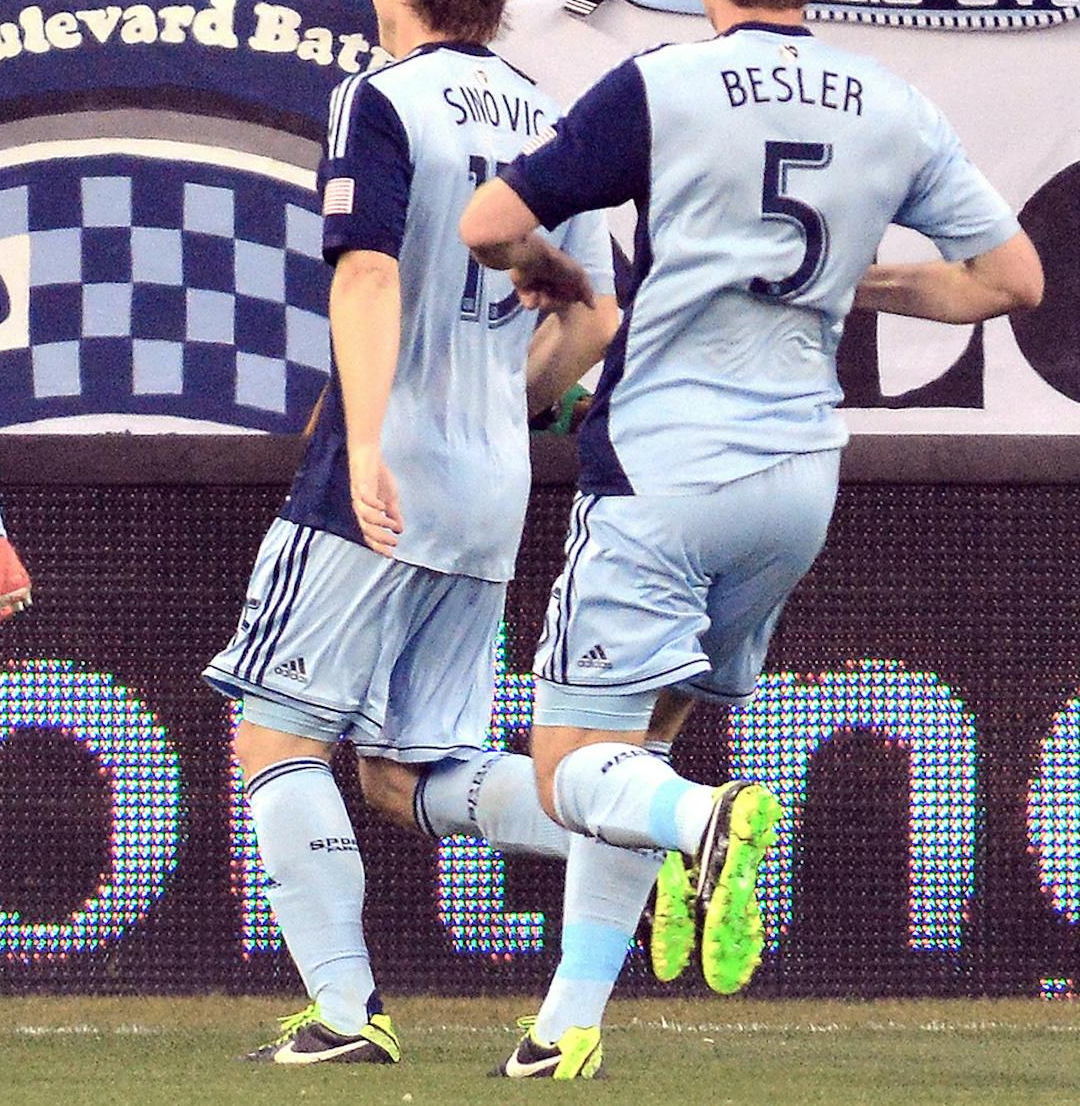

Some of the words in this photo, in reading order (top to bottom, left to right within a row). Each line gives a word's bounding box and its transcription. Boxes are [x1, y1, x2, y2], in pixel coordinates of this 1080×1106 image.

[443, 86, 547, 137] SINOVIC
[720, 67, 864, 117] BESLER
[748, 140, 834, 302] 5
